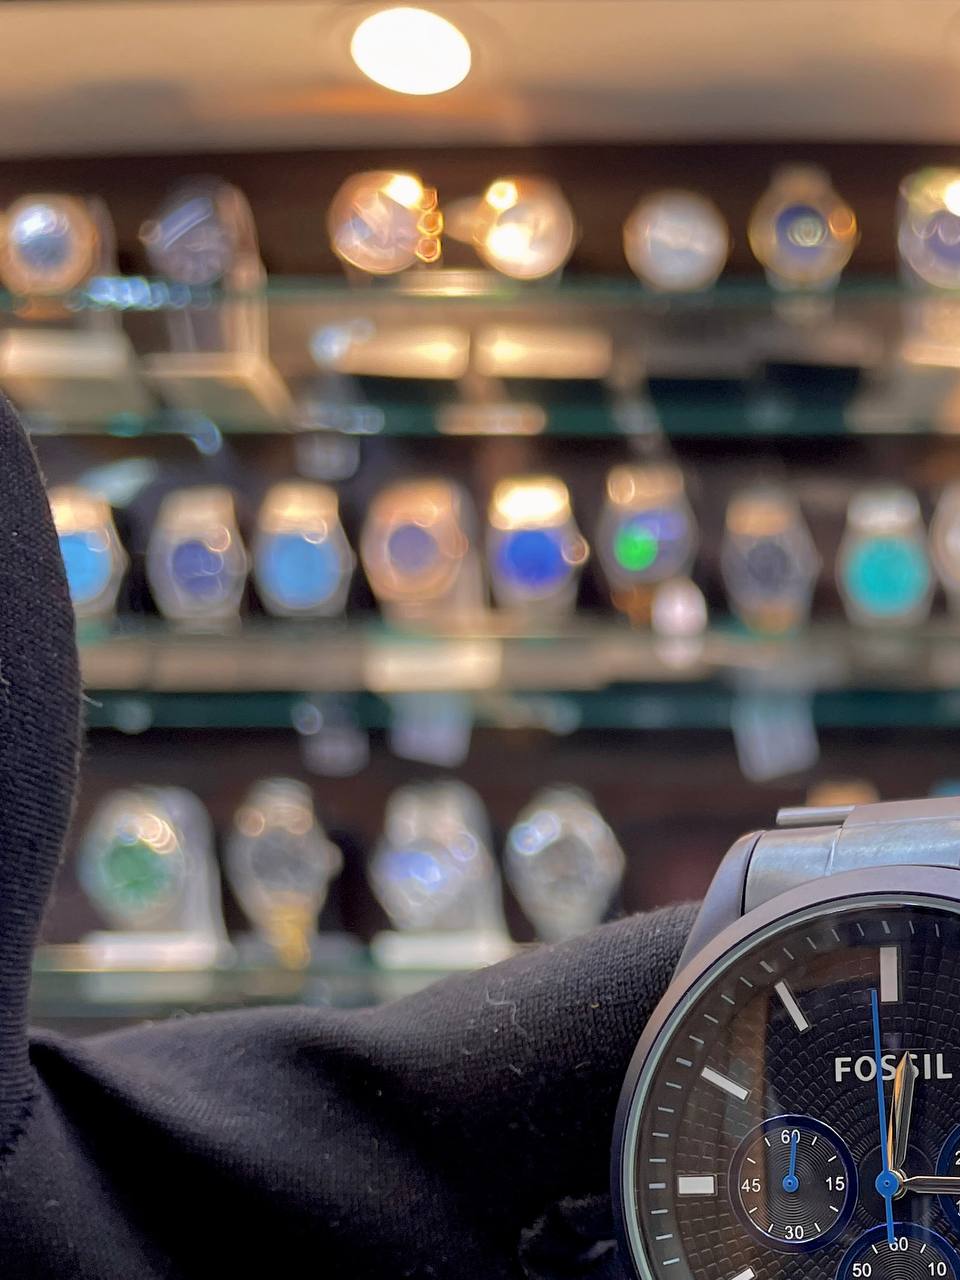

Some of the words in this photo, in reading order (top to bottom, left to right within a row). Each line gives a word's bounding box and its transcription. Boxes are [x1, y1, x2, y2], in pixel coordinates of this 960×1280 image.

[781, 1129, 801, 1144] 60
[741, 1178, 761, 1193] 45
[825, 1176, 845, 1191] 15
[784, 1225, 804, 1240] 30
[888, 1237, 909, 1251] 60
[852, 1263, 872, 1277] 50
[928, 1262, 947, 1276] 10
